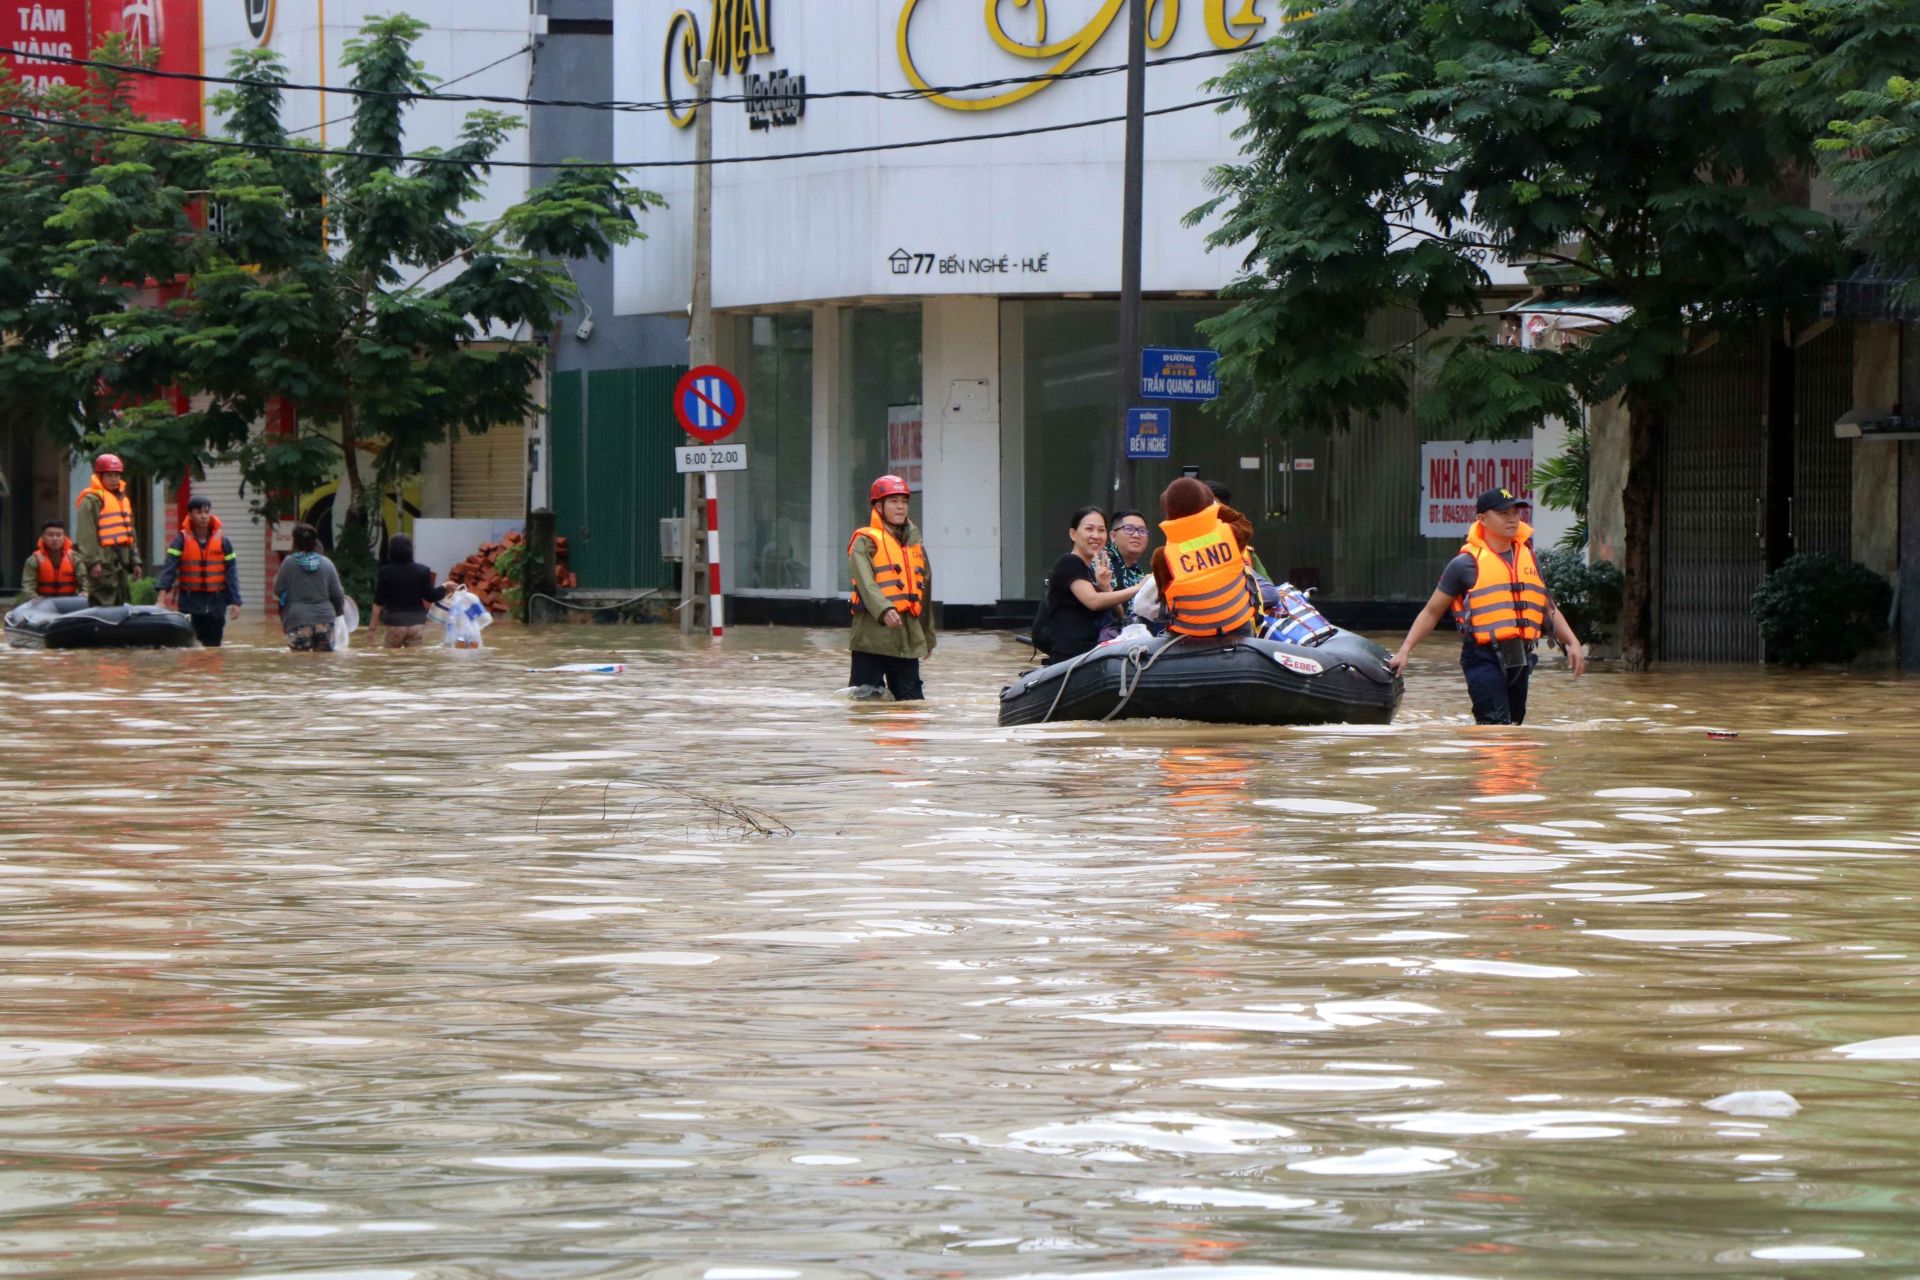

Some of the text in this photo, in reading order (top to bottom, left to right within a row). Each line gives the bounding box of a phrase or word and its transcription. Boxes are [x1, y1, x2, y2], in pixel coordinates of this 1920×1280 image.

[18, 4, 66, 32] TÂM
[13, 37, 72, 65] VÀNG
[913, 253, 935, 274] 77
[939, 254, 965, 274] BẾN
[968, 254, 1009, 273] NGHÉ
[1022, 252, 1049, 272] HUẾ
[1166, 379, 1194, 395] QUANG
[1430, 449, 1460, 499] NHÀ
[1465, 457, 1496, 499] CHO
[1180, 542, 1233, 573] CAND
[1281, 655, 1317, 672] ZEBEC
